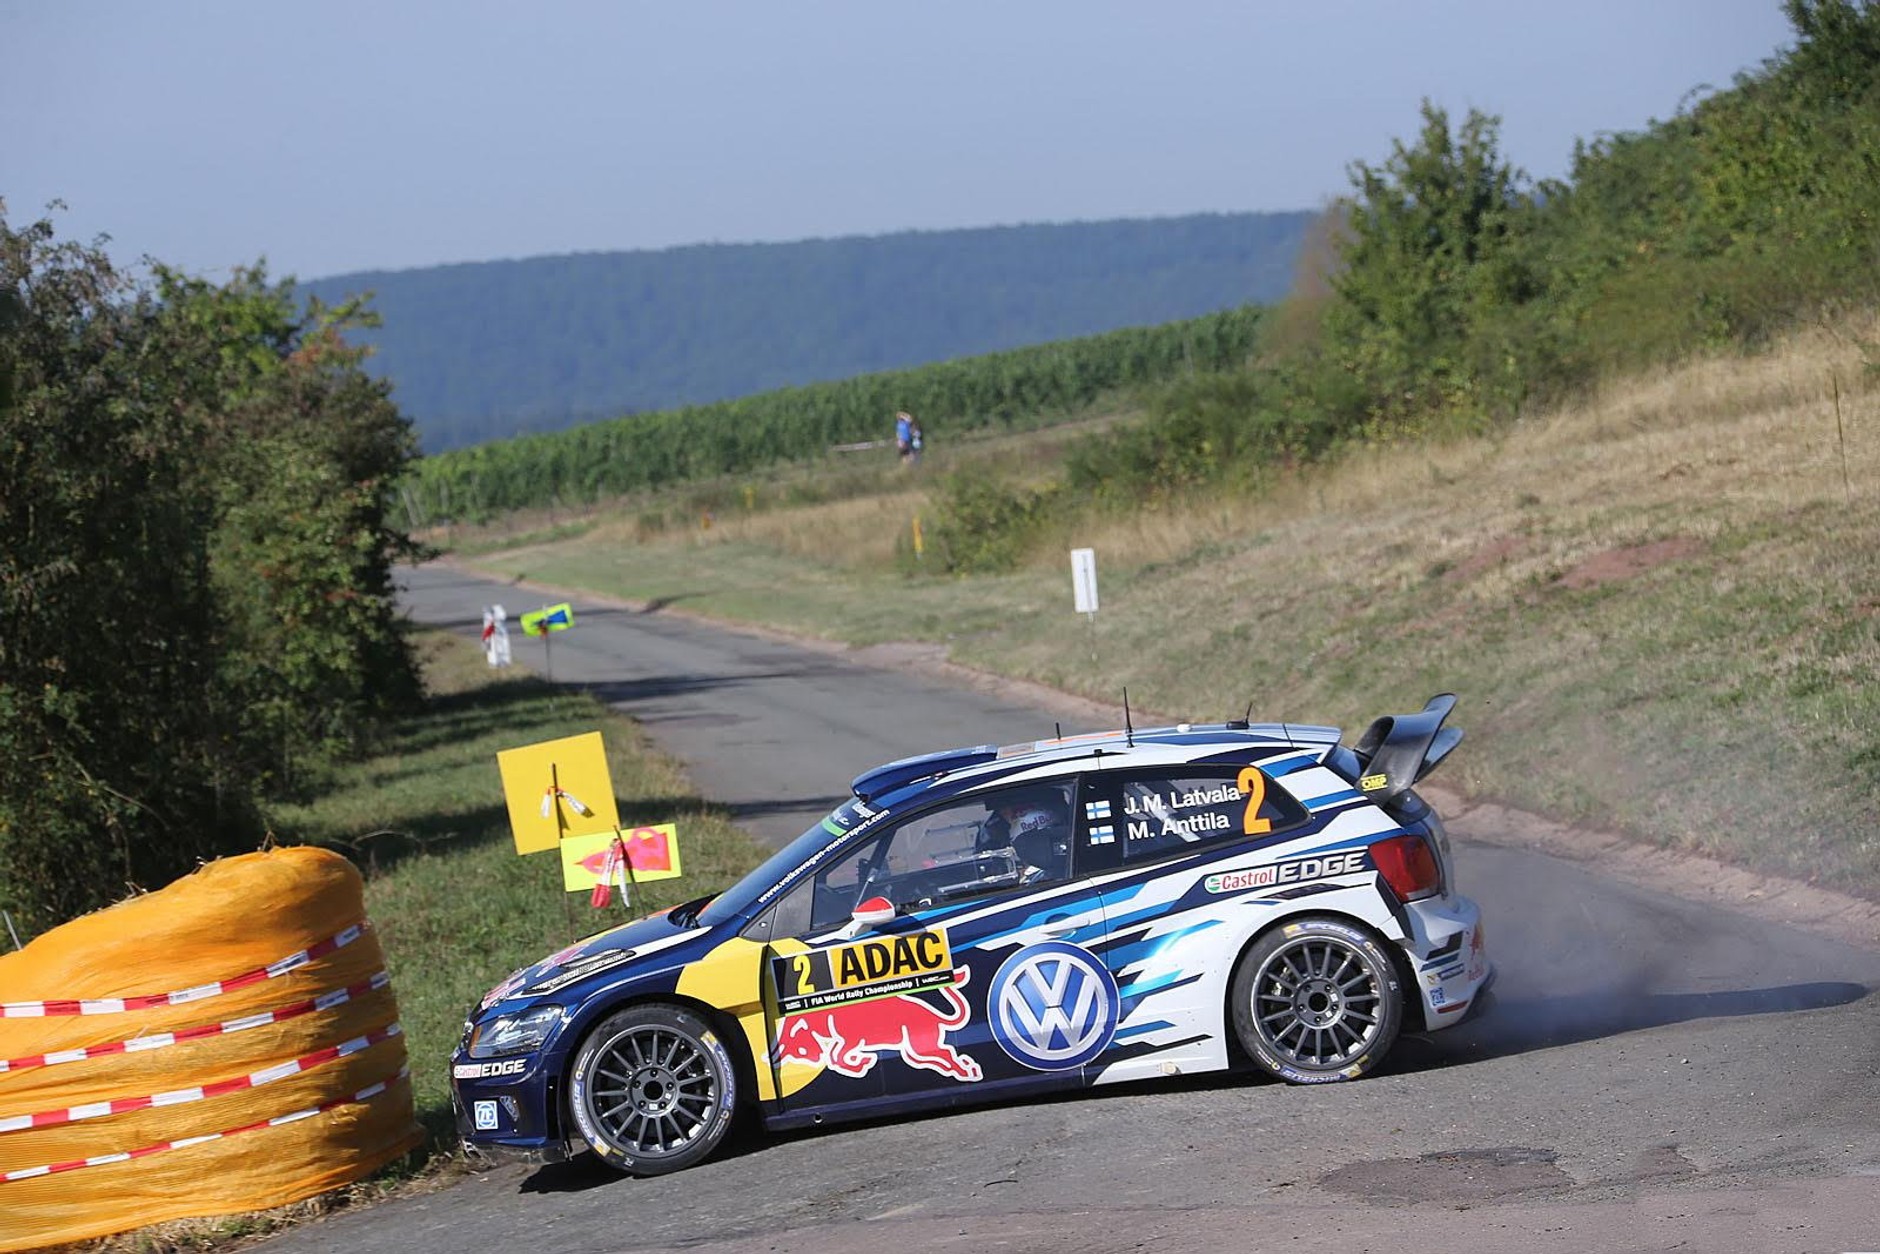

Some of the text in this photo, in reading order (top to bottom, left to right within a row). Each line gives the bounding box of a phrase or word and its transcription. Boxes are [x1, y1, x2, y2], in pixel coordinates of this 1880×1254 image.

[1124, 785, 1241, 815] J. M. Latvala
[1237, 766, 1272, 835] 2
[1128, 812, 1230, 840] M. Anttila
[758, 809, 891, 903] www.volkswagen-motorsport.com
[1222, 852, 1367, 890] Castrol EDGE
[792, 954, 815, 996] 2
[840, 932, 944, 985] ADAC
[810, 996, 824, 1006] FIA
[824, 992, 845, 1005] World
[845, 988, 864, 1000] Rally
[864, 981, 913, 996] Championship
[481, 1059, 527, 1077] EDGE
